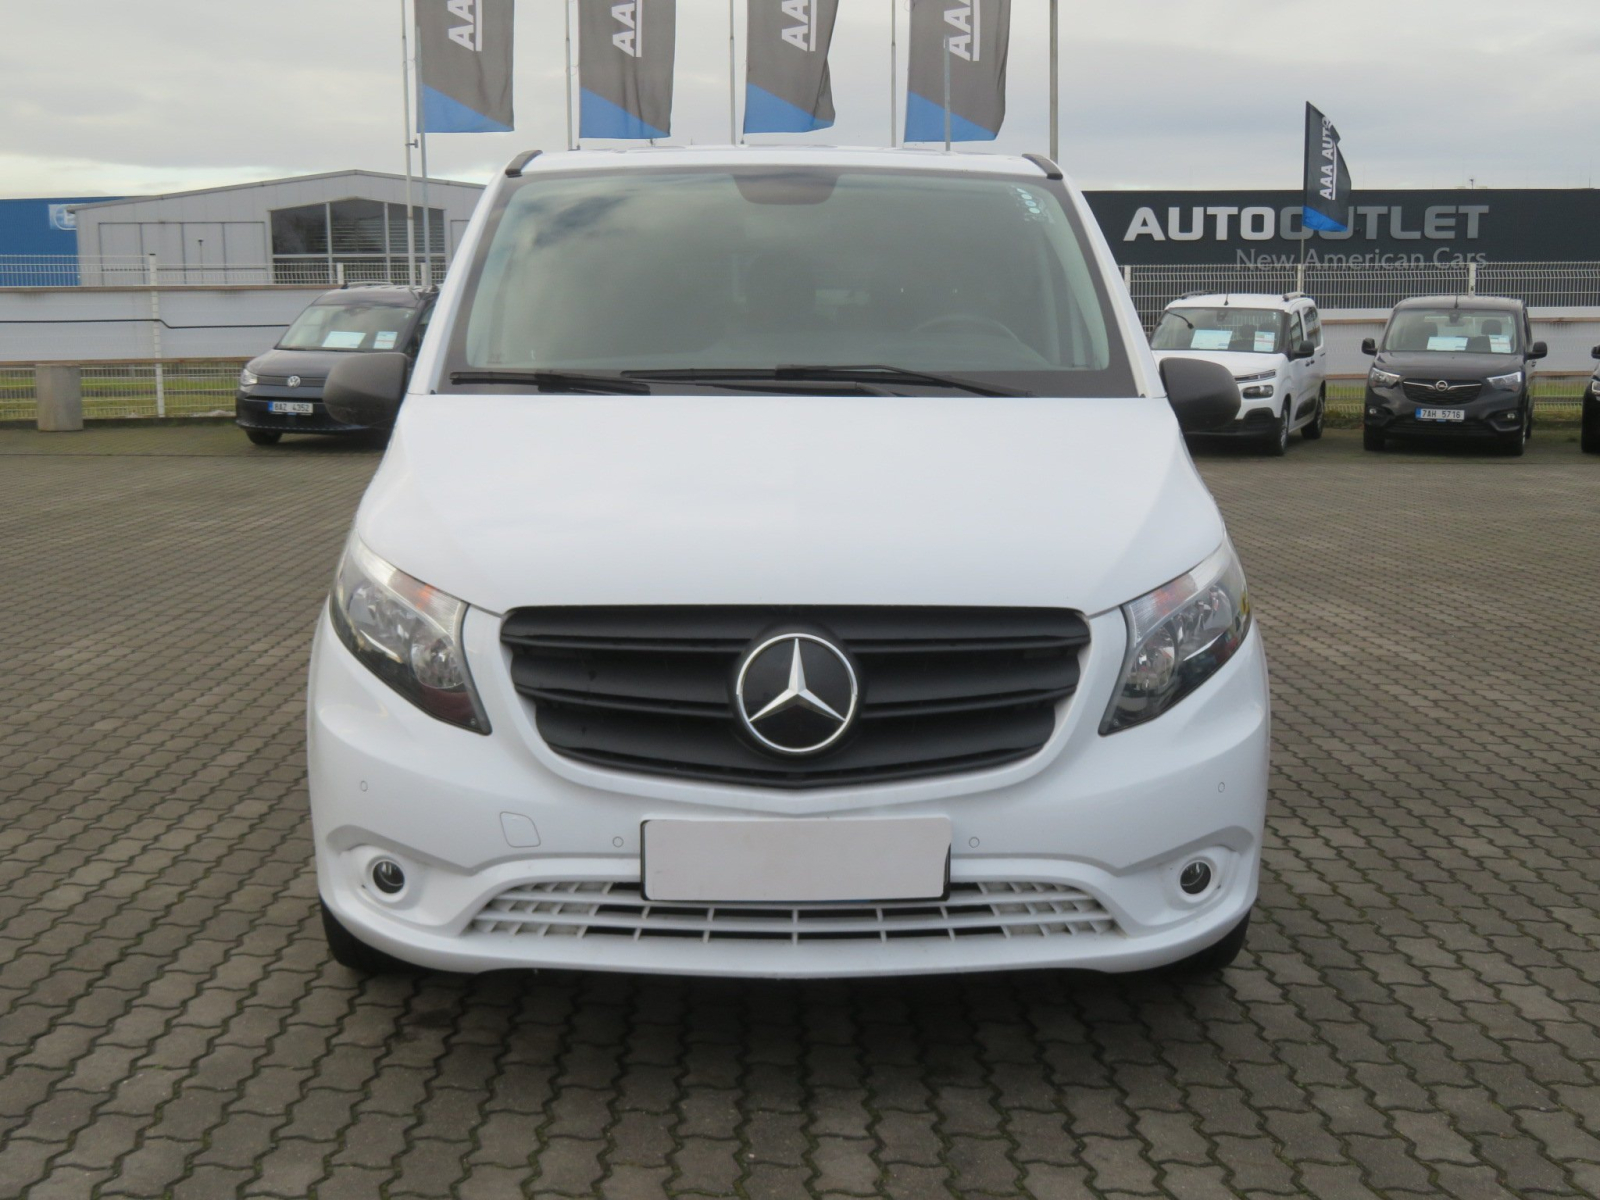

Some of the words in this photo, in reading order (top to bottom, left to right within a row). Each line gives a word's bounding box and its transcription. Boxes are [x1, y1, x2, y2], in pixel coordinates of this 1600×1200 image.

[943, 0, 971, 61] AA
[1319, 164, 1333, 200] AAA
[1235, 248, 1295, 270] New
[1303, 248, 1425, 270] American
[1432, 247, 1487, 269] Cars
[1422, 409, 1437, 418] 7AH
[1441, 410, 1461, 419] 5716
